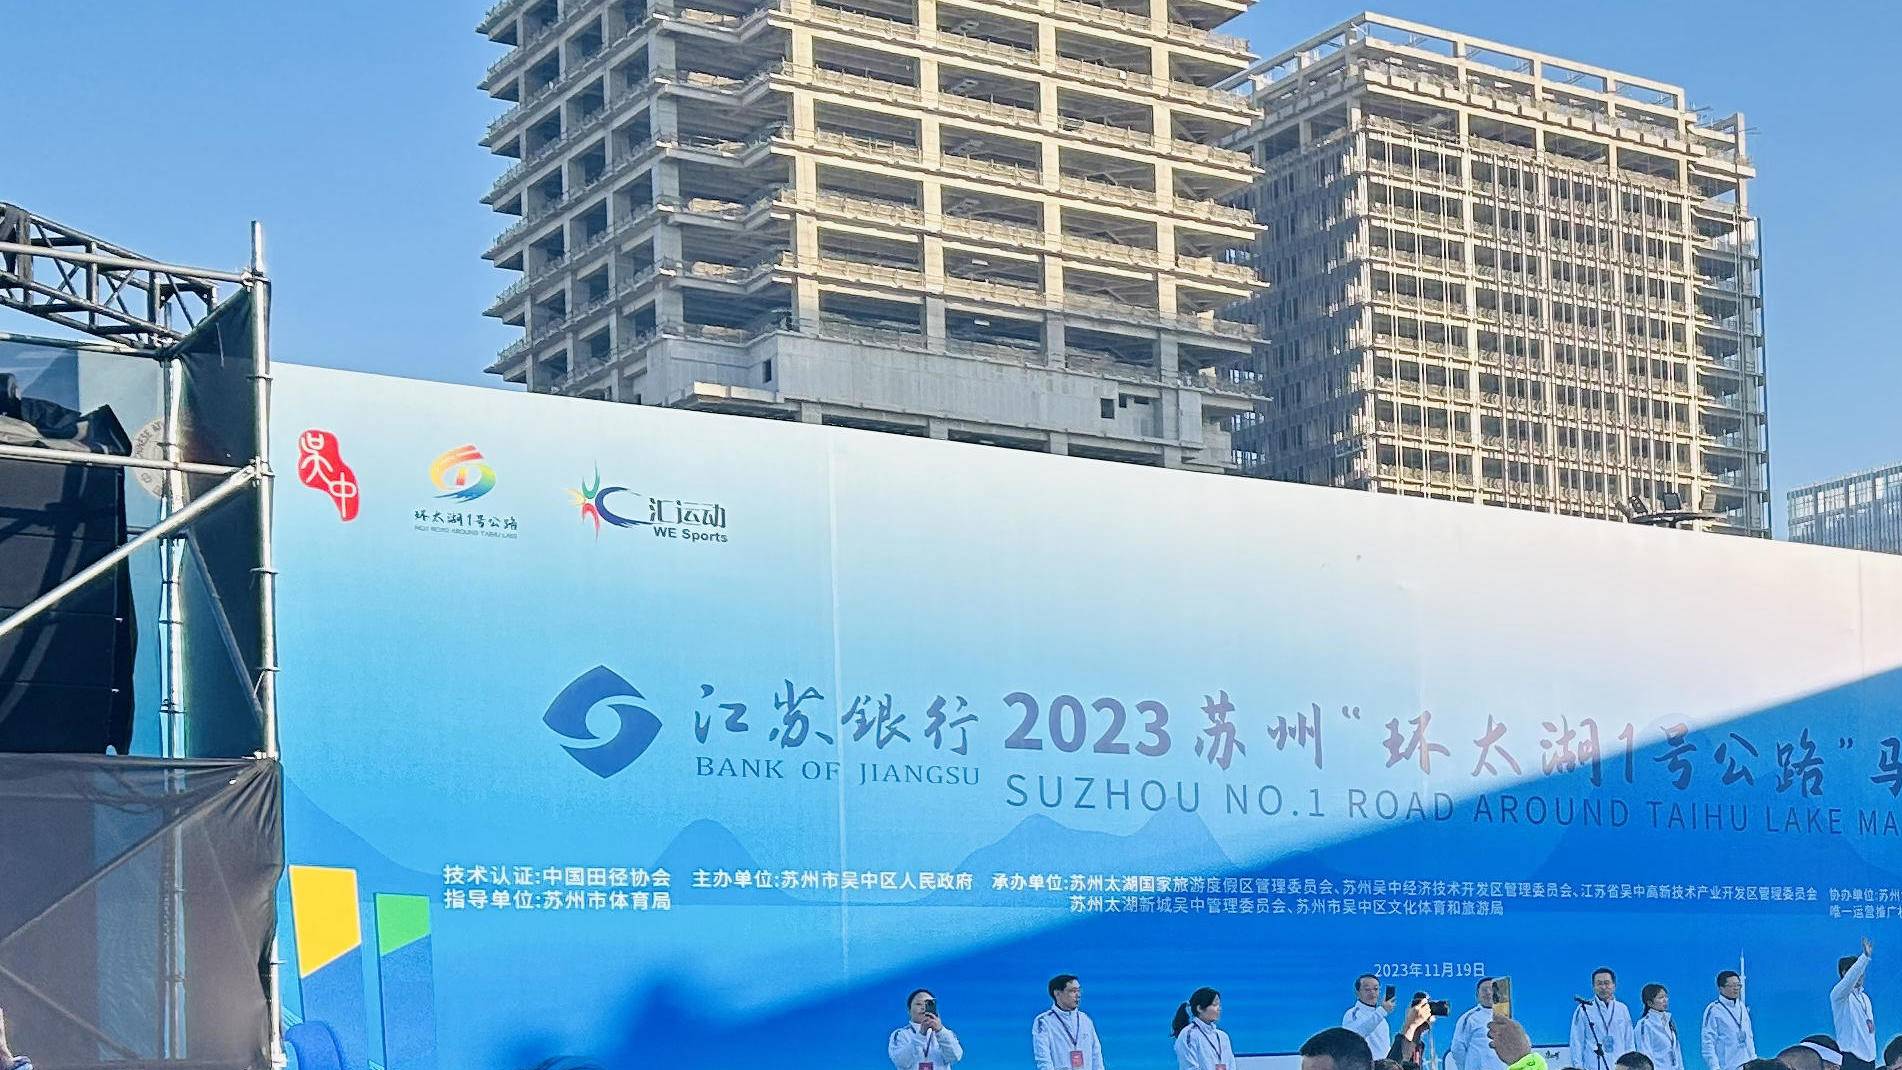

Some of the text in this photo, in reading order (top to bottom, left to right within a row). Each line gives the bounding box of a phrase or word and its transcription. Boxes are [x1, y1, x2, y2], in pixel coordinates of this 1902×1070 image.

[649, 497, 726, 529] 汇运动
[653, 526, 729, 543] WE Sports
[694, 678, 980, 757] 江苏银行
[695, 756, 981, 787] BANK OF JIANGSU
[1006, 773, 1200, 814] SUZHOU
[1226, 782, 1326, 818] NO.1
[1348, 788, 1454, 822] ROAD
[1474, 793, 1630, 828] AROUND
[1646, 801, 1750, 832] TAIHU
[1767, 806, 1843, 836] LAKE
[442, 864, 672, 887] 技术认证:中国田径协会
[442, 889, 672, 911] 指导单位:苏州市体育局
[1374, 962, 1486, 979] 2023年11月19日
